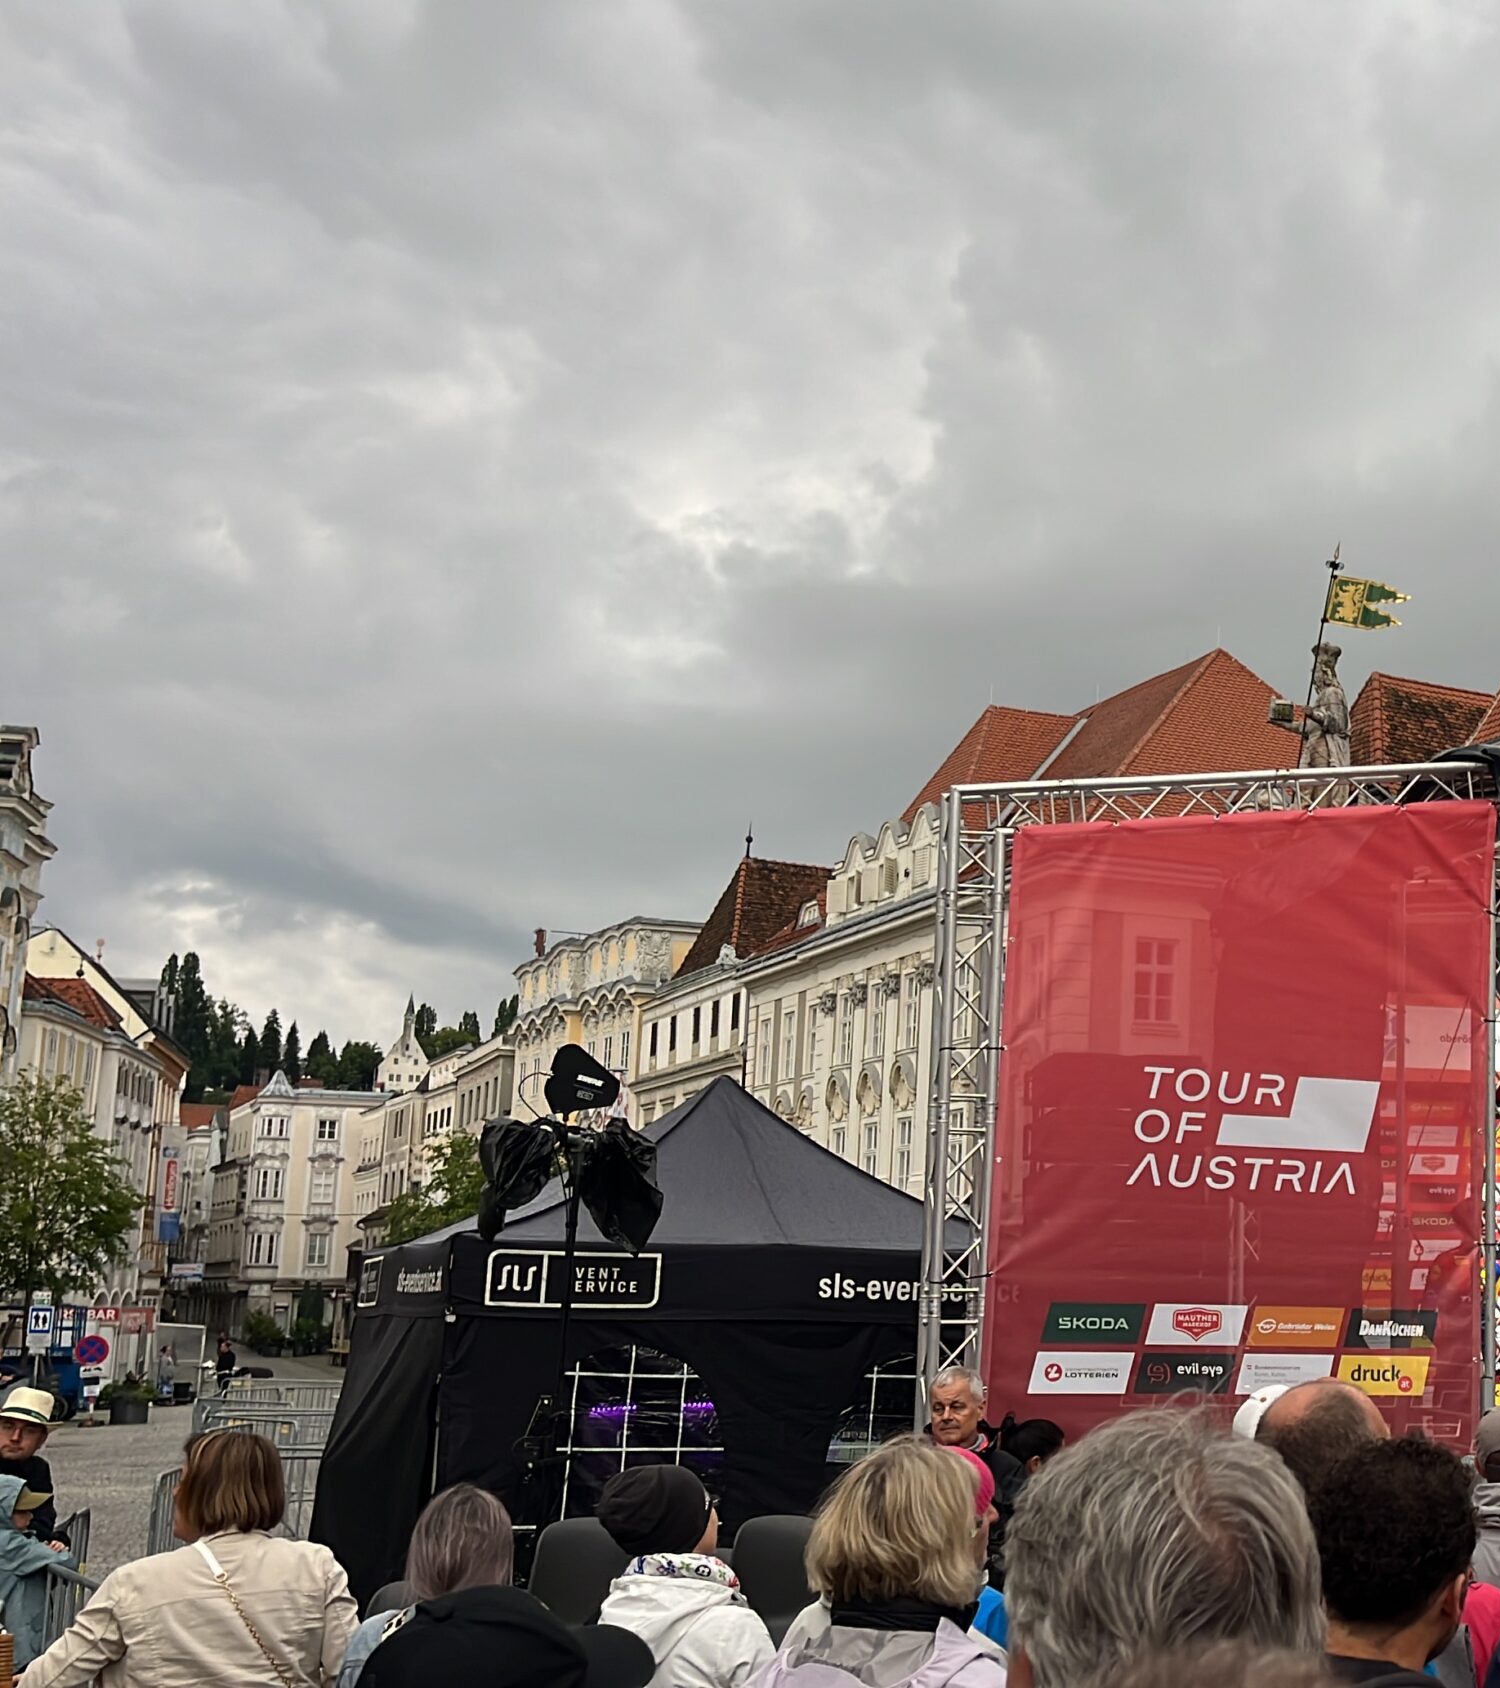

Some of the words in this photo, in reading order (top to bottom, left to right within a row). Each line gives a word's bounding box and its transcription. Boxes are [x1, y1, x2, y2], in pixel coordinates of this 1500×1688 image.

[1144, 1066, 1285, 1106] TOUR
[1134, 1109, 1206, 1144] OF
[1126, 1153, 1356, 1195] AUSTRIA
[87, 1309, 115, 1320] BAR
[1177, 1314, 1218, 1322] MAUTNER
[1064, 1371, 1119, 1379] LOTTERIEN
[1176, 1363, 1199, 1375] evil
[1351, 1364, 1401, 1382] druck
